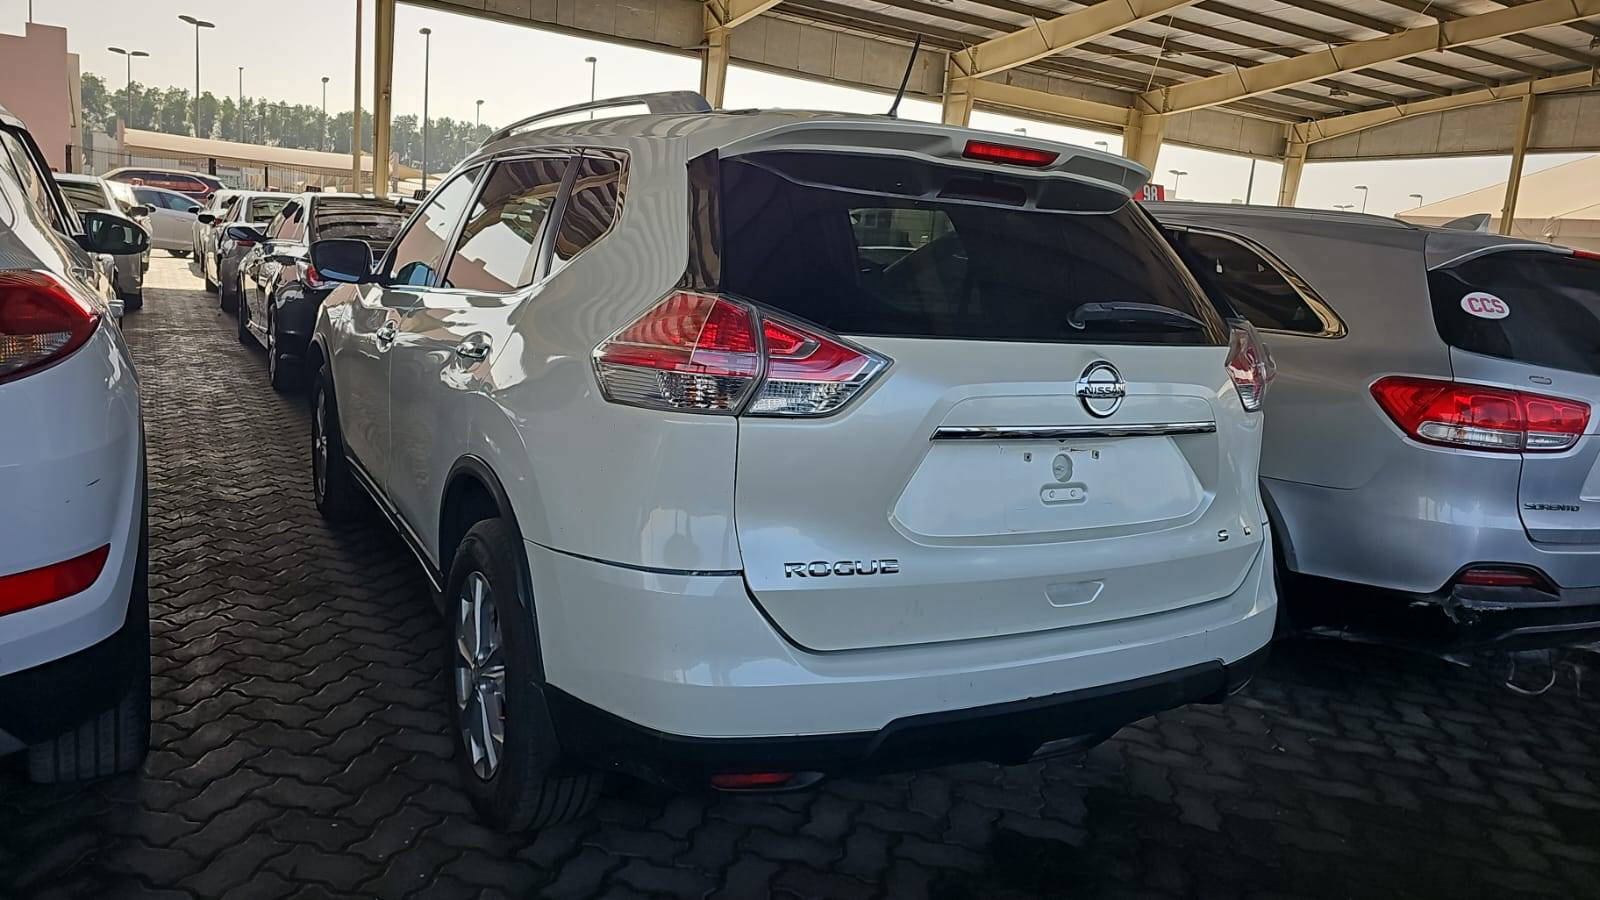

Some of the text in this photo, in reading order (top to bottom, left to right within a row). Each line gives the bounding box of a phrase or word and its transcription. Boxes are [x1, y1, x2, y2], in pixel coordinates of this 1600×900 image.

[1143, 184, 1158, 200] 98
[1467, 297, 1505, 313] CCS
[1083, 386, 1123, 395] NISSAN
[1523, 503, 1580, 512] SORENTO
[783, 559, 899, 578] ROGUE
